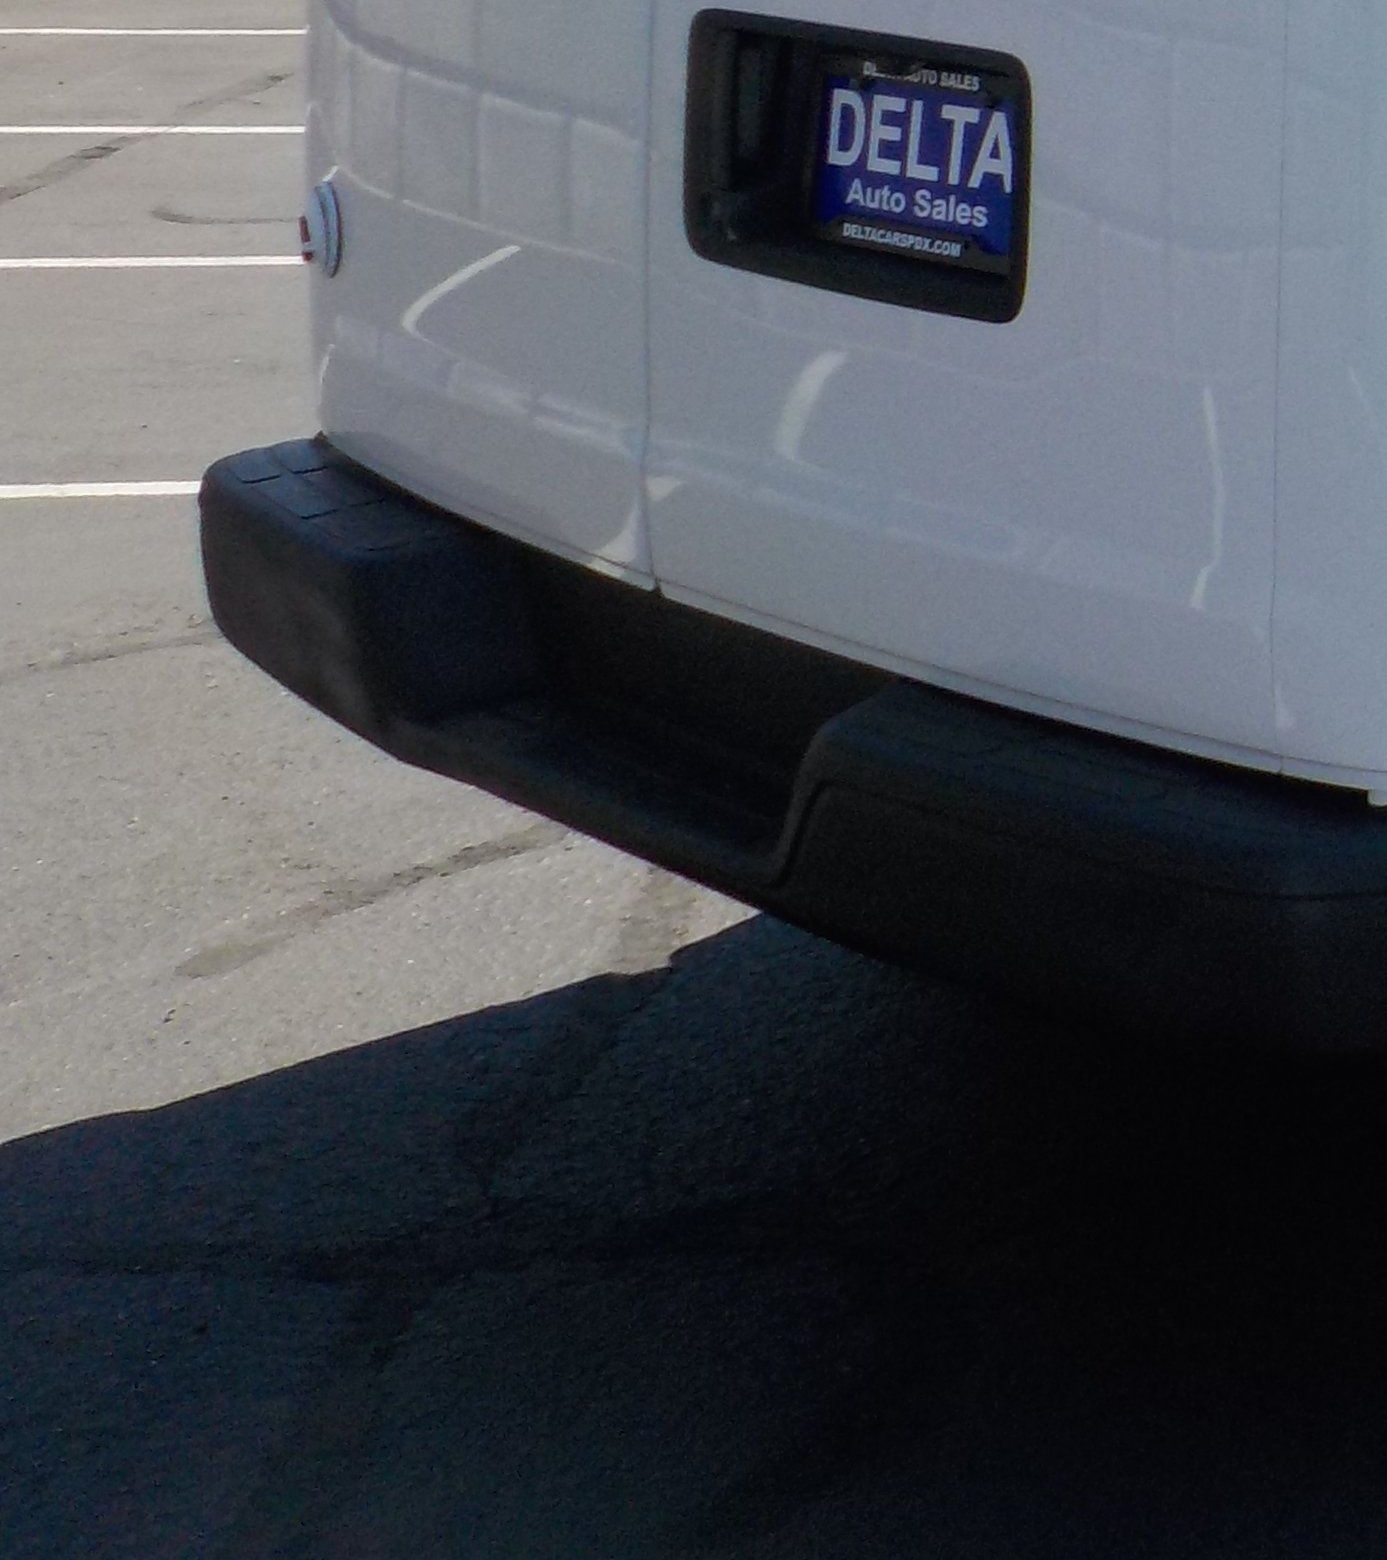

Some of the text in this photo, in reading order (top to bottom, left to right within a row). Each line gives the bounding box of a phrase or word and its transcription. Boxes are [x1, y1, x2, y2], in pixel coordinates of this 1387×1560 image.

[940, 71, 980, 92] SALES
[827, 88, 1013, 194] DELTA
[845, 177, 989, 228] Auto Sales
[842, 222, 962, 258] DELTACARSPDX.COM
